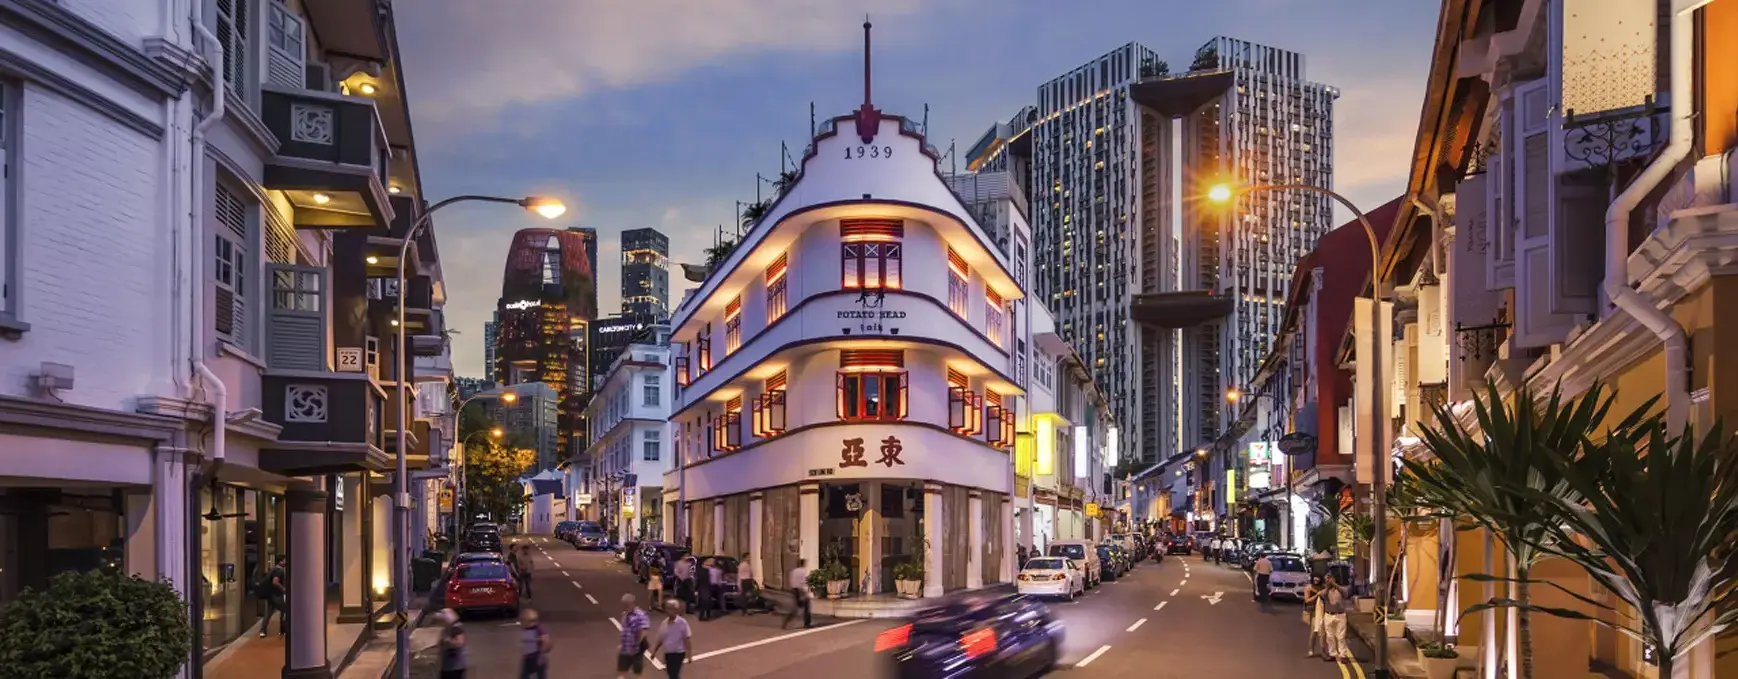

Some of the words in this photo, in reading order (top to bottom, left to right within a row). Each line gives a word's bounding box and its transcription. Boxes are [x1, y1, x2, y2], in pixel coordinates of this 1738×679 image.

[844, 145, 892, 160] 1939
[837, 311, 875, 319] POTATO
[879, 311, 907, 319] HEAD
[342, 355, 357, 365] 22
